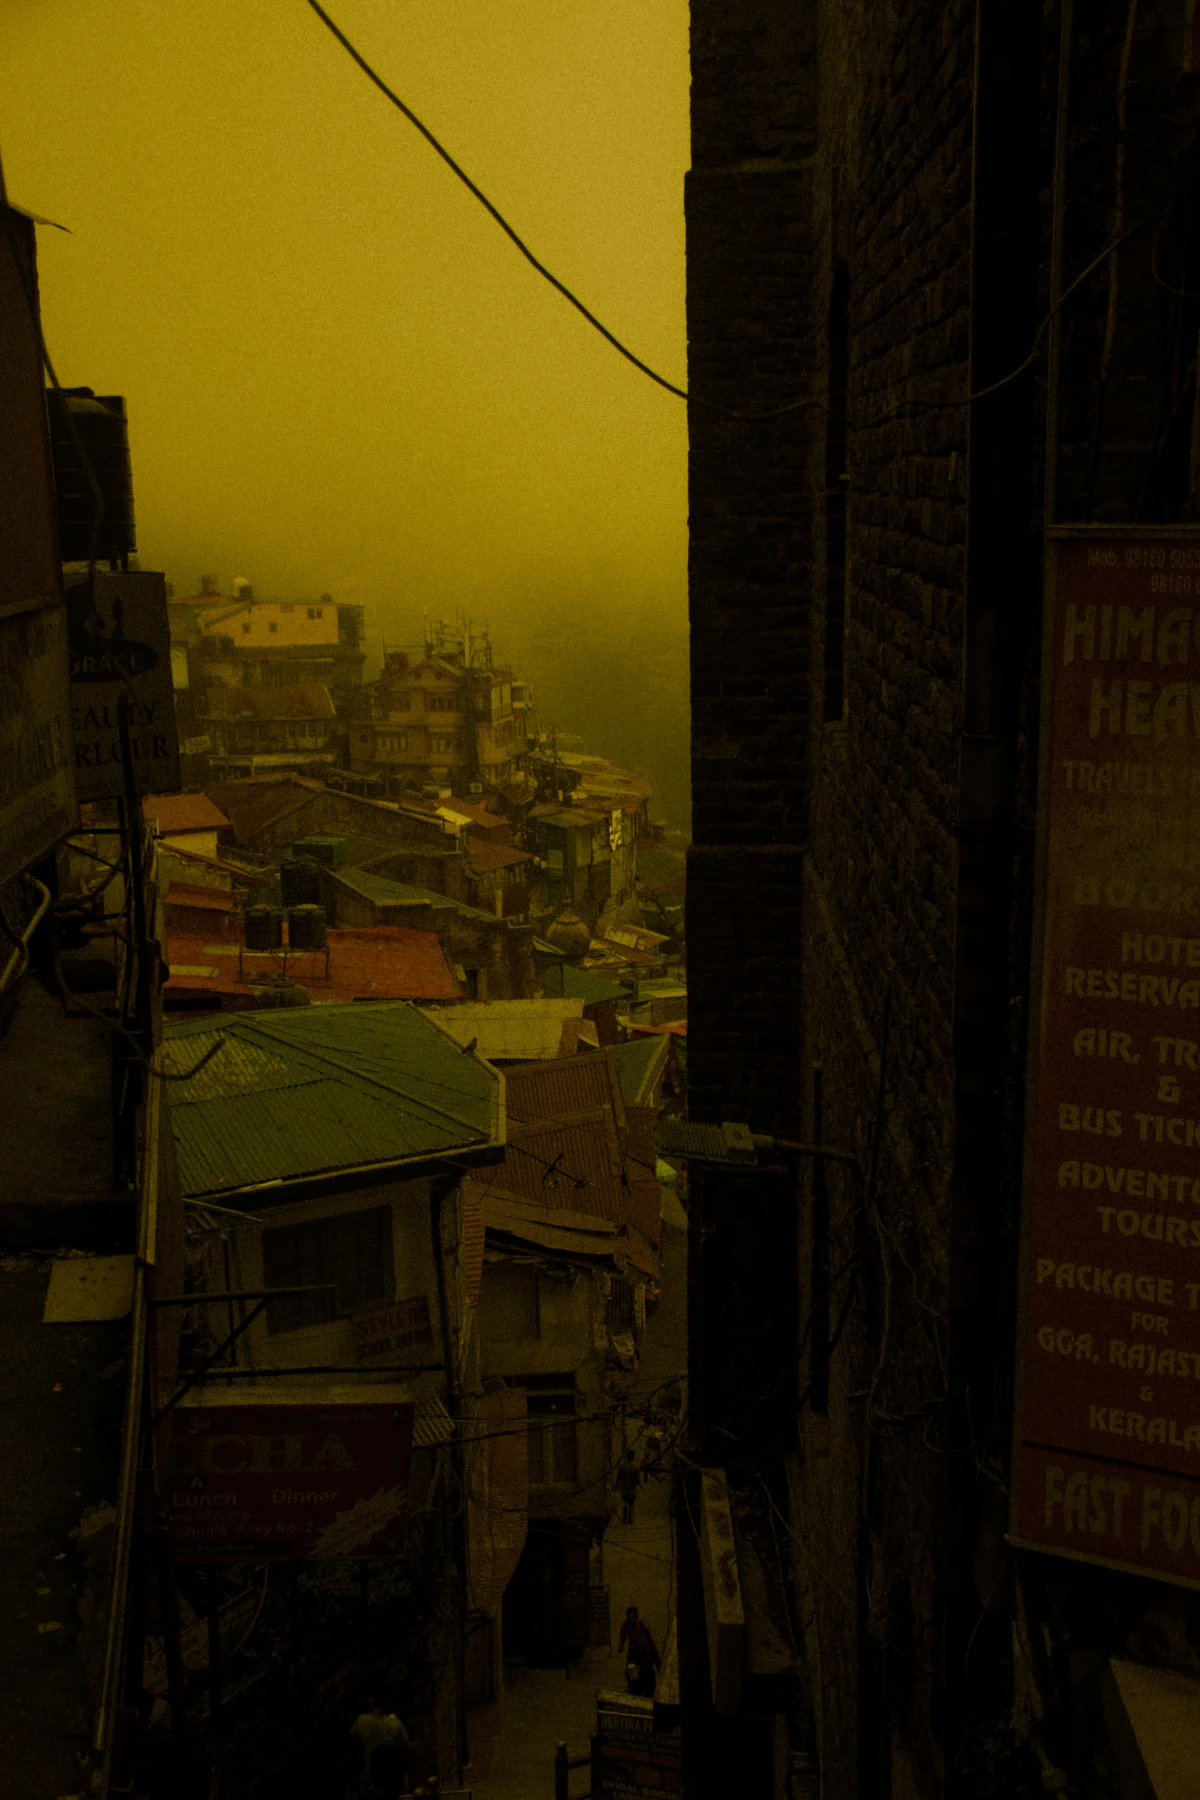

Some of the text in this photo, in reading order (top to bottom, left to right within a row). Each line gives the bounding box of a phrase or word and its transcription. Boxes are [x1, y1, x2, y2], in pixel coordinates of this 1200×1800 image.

[1063, 602, 1200, 670] HIMA
[71, 702, 157, 731] EAUTY
[75, 736, 171, 768] RLOUR
[1157, 1075, 1181, 1104] &
[1058, 1102, 1123, 1138] BUS
[1036, 1257, 1176, 1307] PACKAGE
[1130, 1311, 1169, 1337] FOR
[1139, 1384, 1154, 1402] &
[1088, 1404, 1200, 1453] KERALA
[173, 1488, 340, 1507] Lunch Dinner
[1044, 1463, 1131, 1541] FAST
